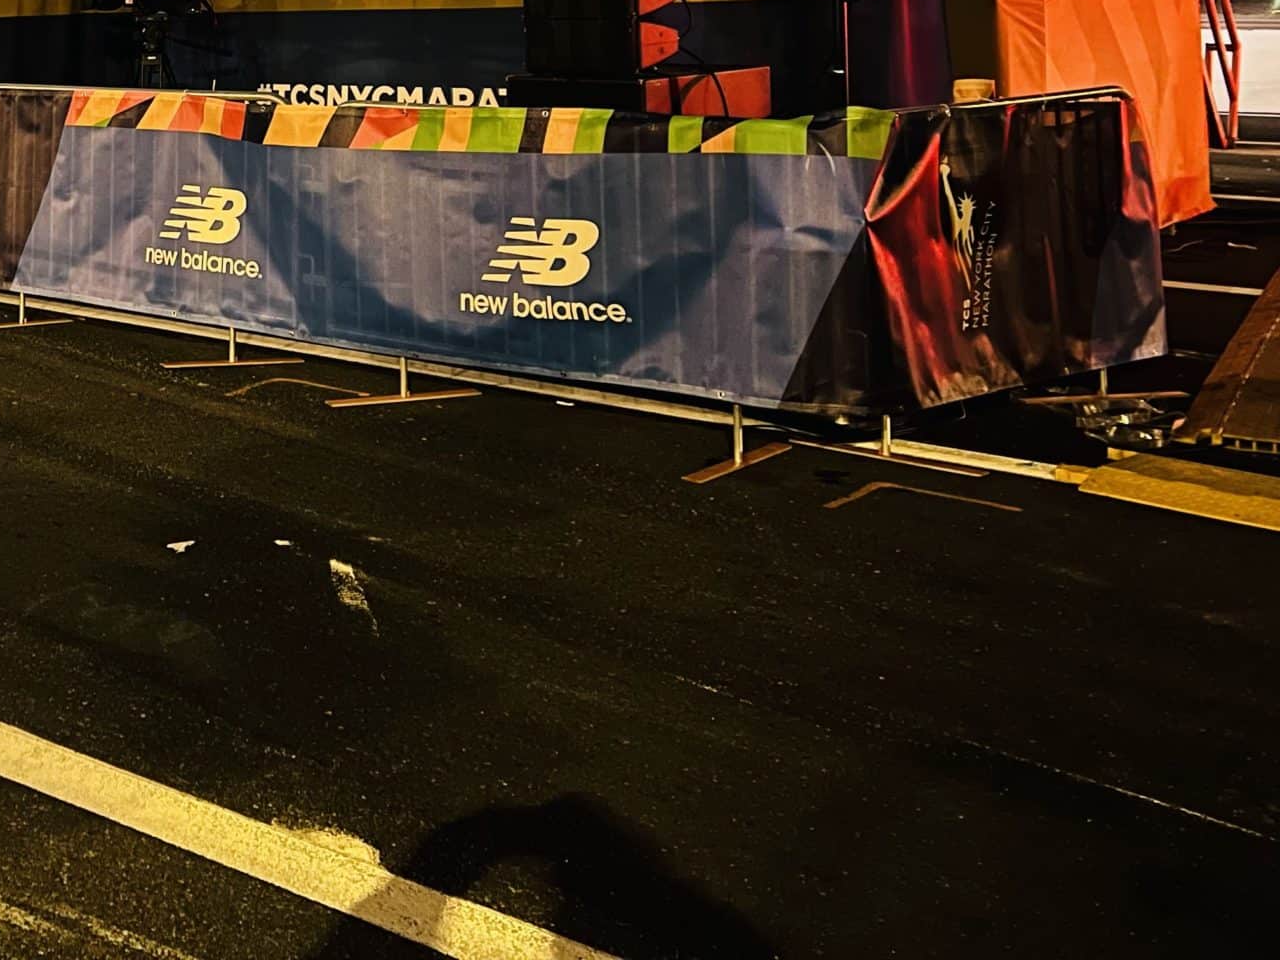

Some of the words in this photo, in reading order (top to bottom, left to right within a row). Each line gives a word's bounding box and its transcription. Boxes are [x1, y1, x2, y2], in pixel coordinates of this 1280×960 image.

[256, 83, 508, 108] #TCSNYCMARA
[980, 200, 997, 236] CITY
[145, 246, 178, 267] new
[975, 240, 985, 286] YORK
[981, 233, 999, 328] MARATHON
[459, 292, 508, 316] new
[961, 298, 970, 332] TCS
[972, 290, 981, 328] NEW
